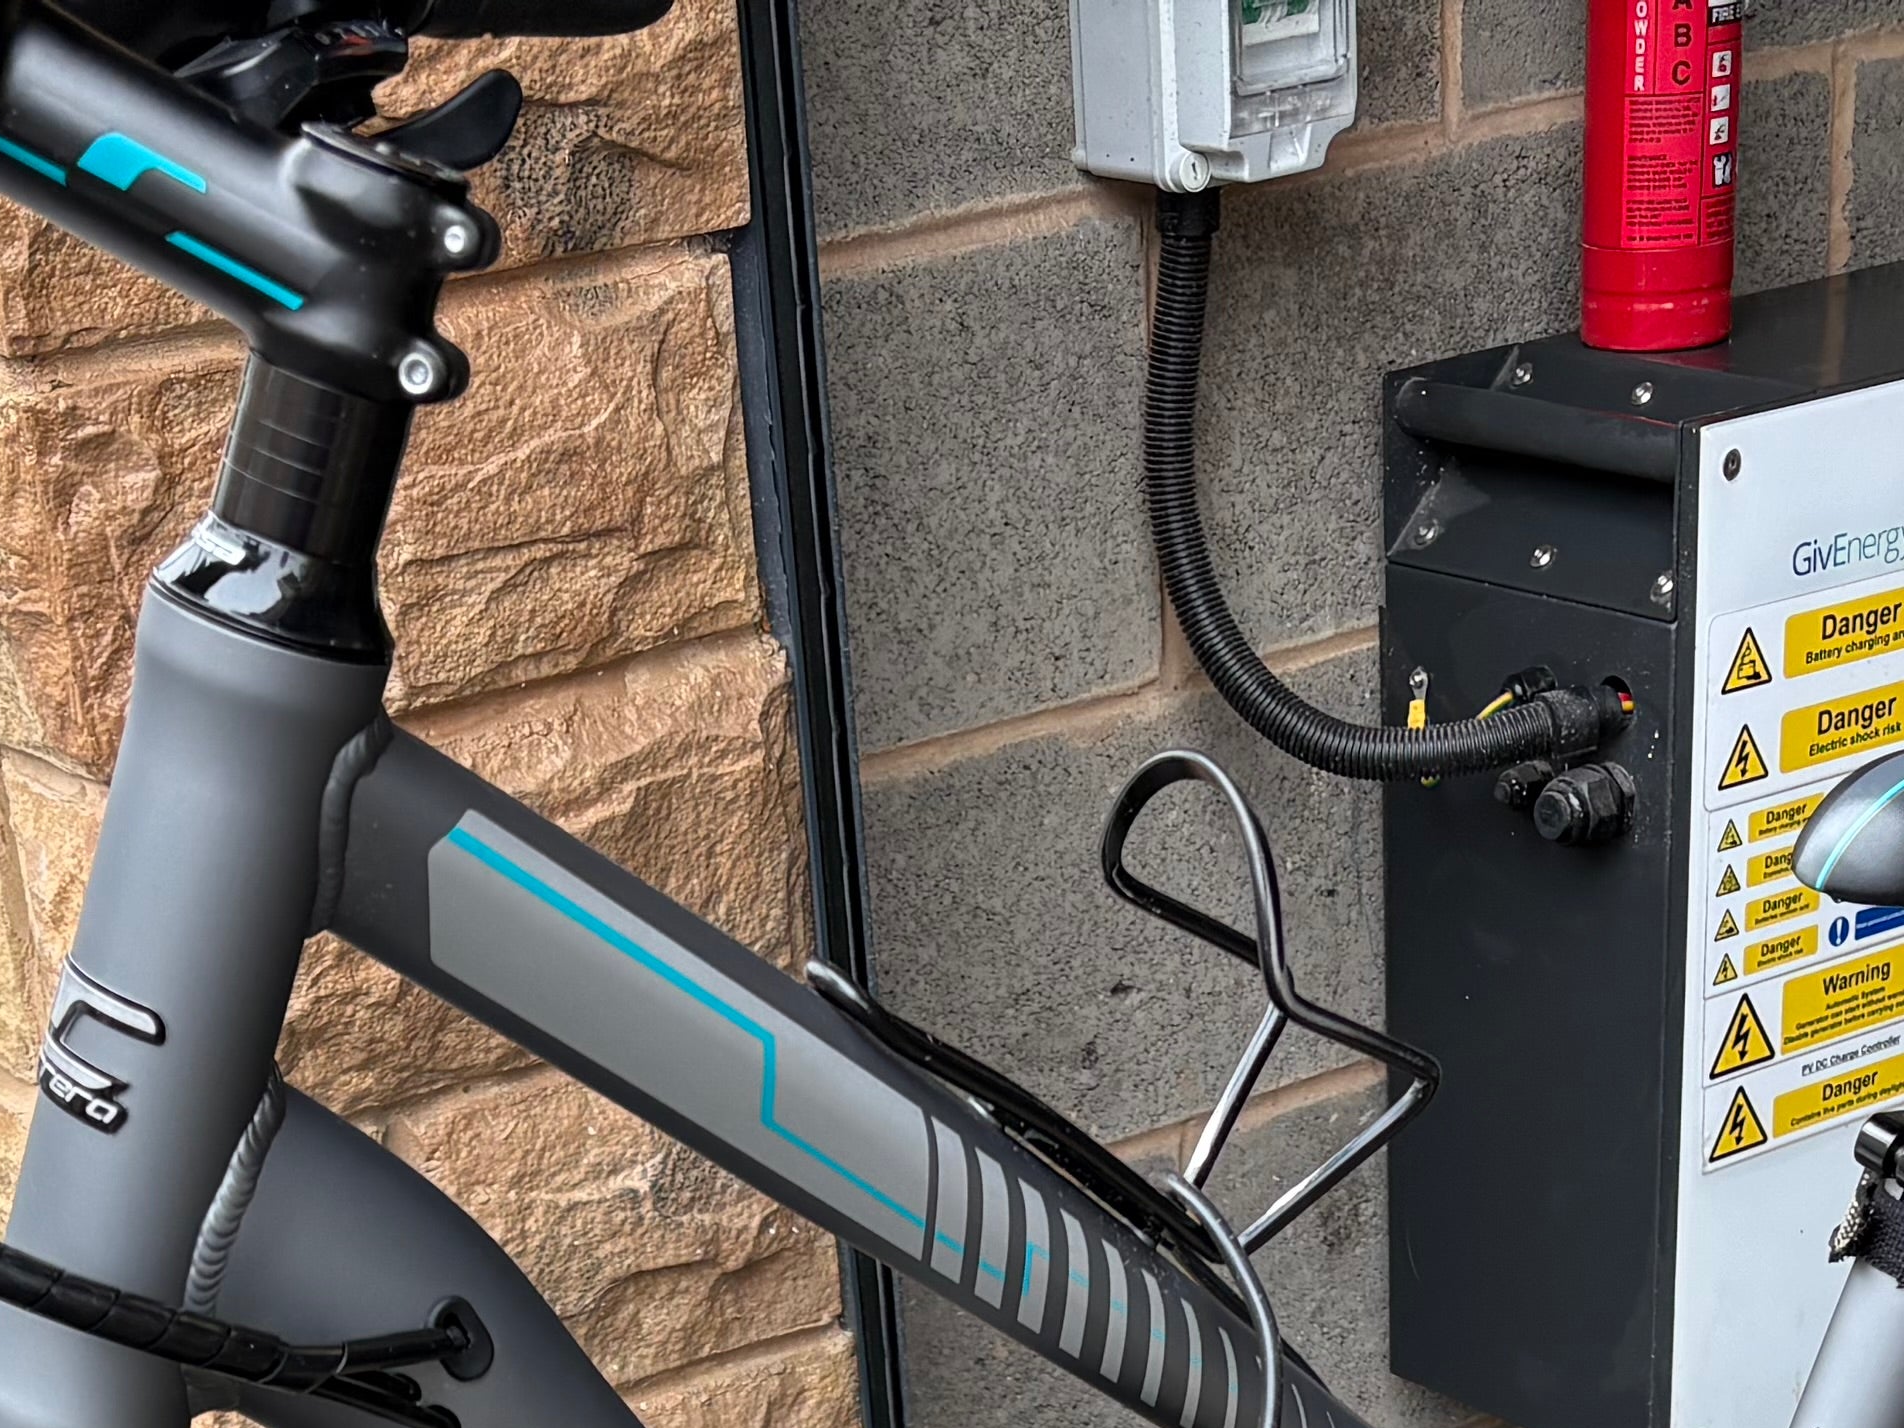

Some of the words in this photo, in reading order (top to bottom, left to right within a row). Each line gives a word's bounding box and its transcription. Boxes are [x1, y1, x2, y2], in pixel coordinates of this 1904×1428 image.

[1821, 602, 1903, 641] Danger
[1805, 641, 1843, 665] Battery
[1844, 631, 1891, 654] charging
[1816, 696, 1897, 736] Danger
[1808, 736, 1848, 758] Electric
[1849, 729, 1881, 746] shock
[1882, 721, 1902, 736] risk
[1765, 802, 1808, 825] Danger
[1764, 852, 1794, 870] Dang
[1762, 891, 1804, 914] Danger
[1760, 935, 1802, 957] Danger
[1822, 961, 1892, 996] Warning
[1801, 1063, 1814, 1077] PV
[1815, 1056, 1829, 1072] DC
[1829, 1047, 1860, 1067] Charge
[1860, 1035, 1902, 1055] Controller
[1821, 1071, 1879, 1101] Danger
